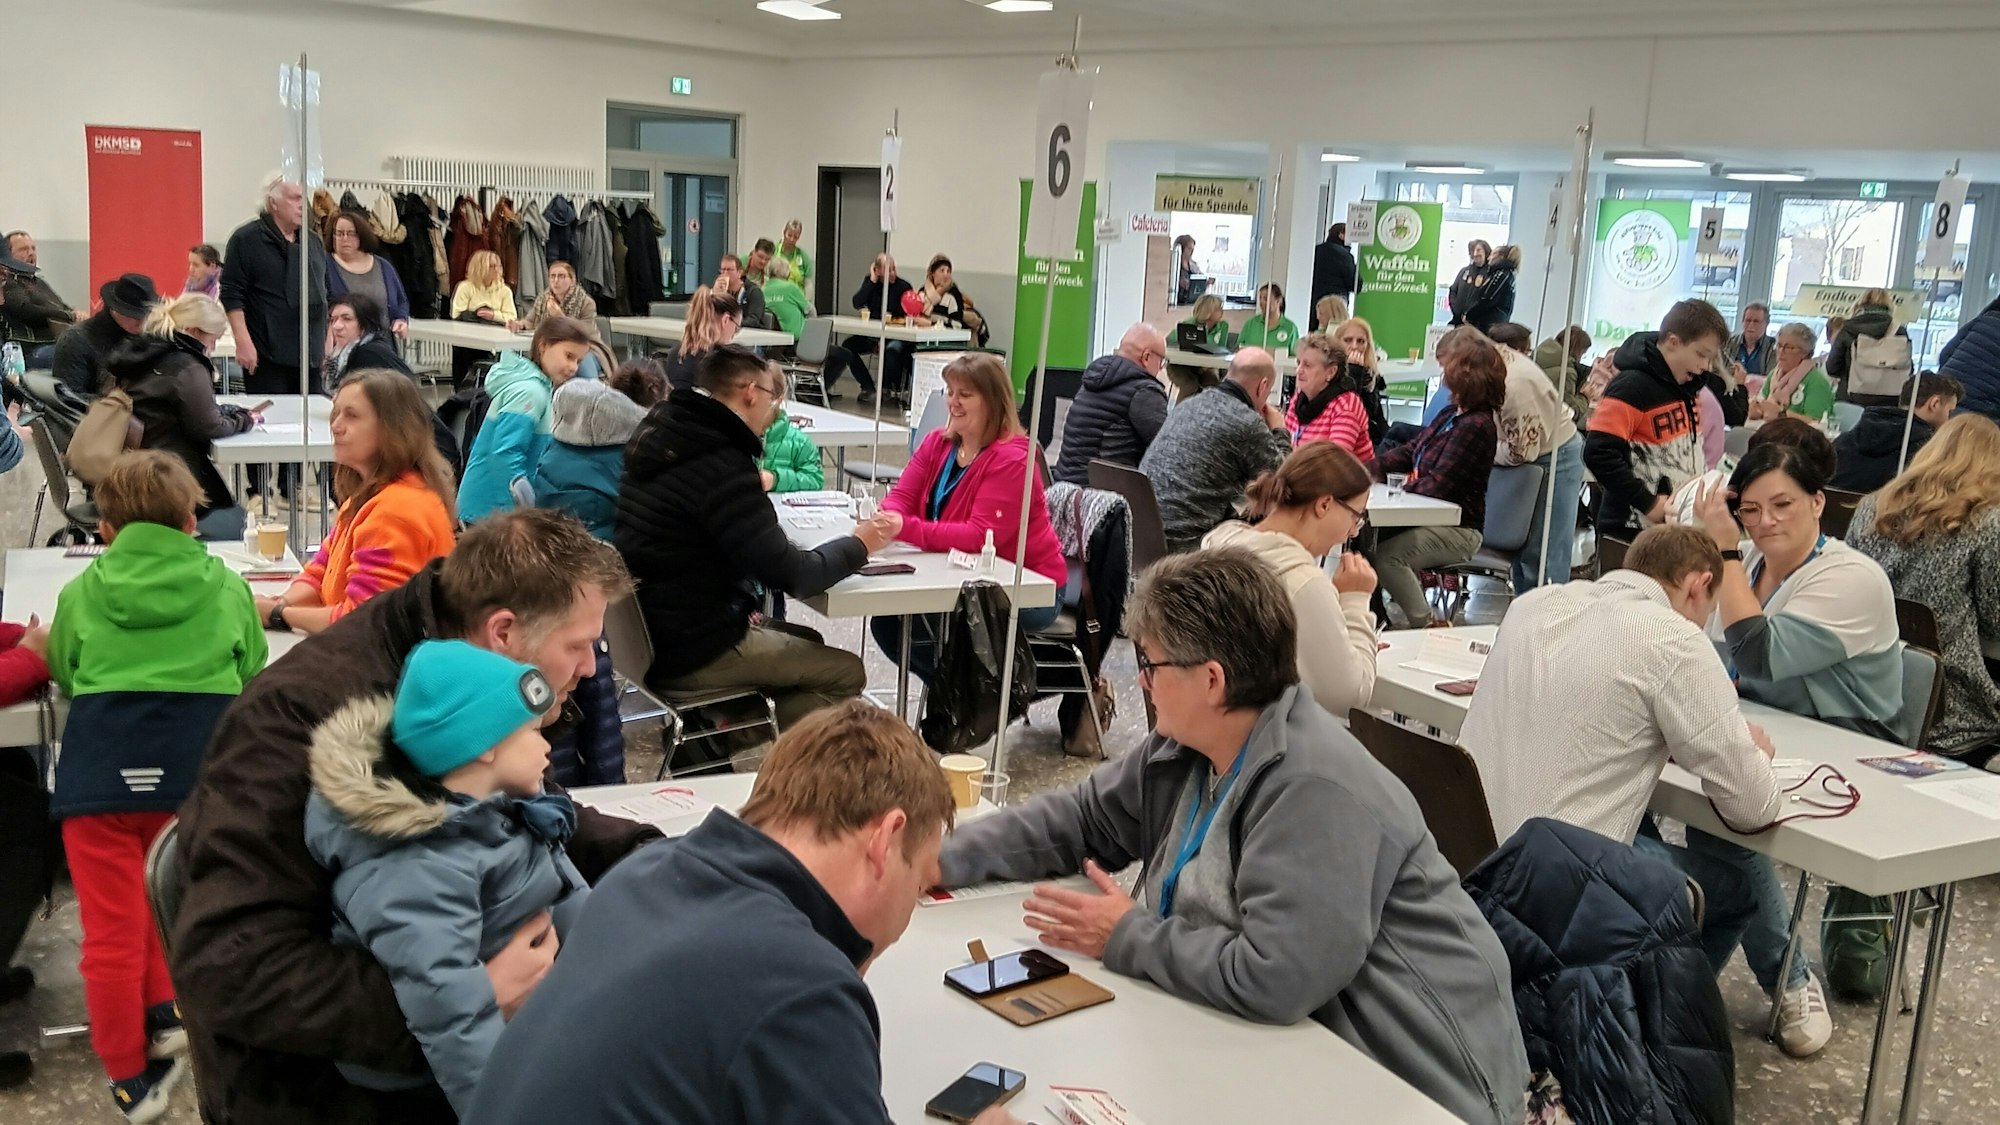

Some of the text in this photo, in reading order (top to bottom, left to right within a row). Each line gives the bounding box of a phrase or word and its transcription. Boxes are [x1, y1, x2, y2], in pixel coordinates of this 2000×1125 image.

[95, 135, 130, 150] DKMS
[1048, 123, 1070, 198] 6
[886, 163, 894, 201] 2
[1189, 183, 1223, 197] Danke
[1163, 195, 1248, 213] für Ihre Spende
[1132, 214, 1169, 233] Cafeteria
[1353, 220, 1368, 230] LEO
[1550, 203, 1559, 229] 4
[1936, 201, 1951, 238] 8
[1705, 220, 1717, 240] 5
[1364, 254, 1430, 272] Waffeln
[1376, 270, 1415, 282] für den
[1361, 281, 1429, 293] guten Zweck
